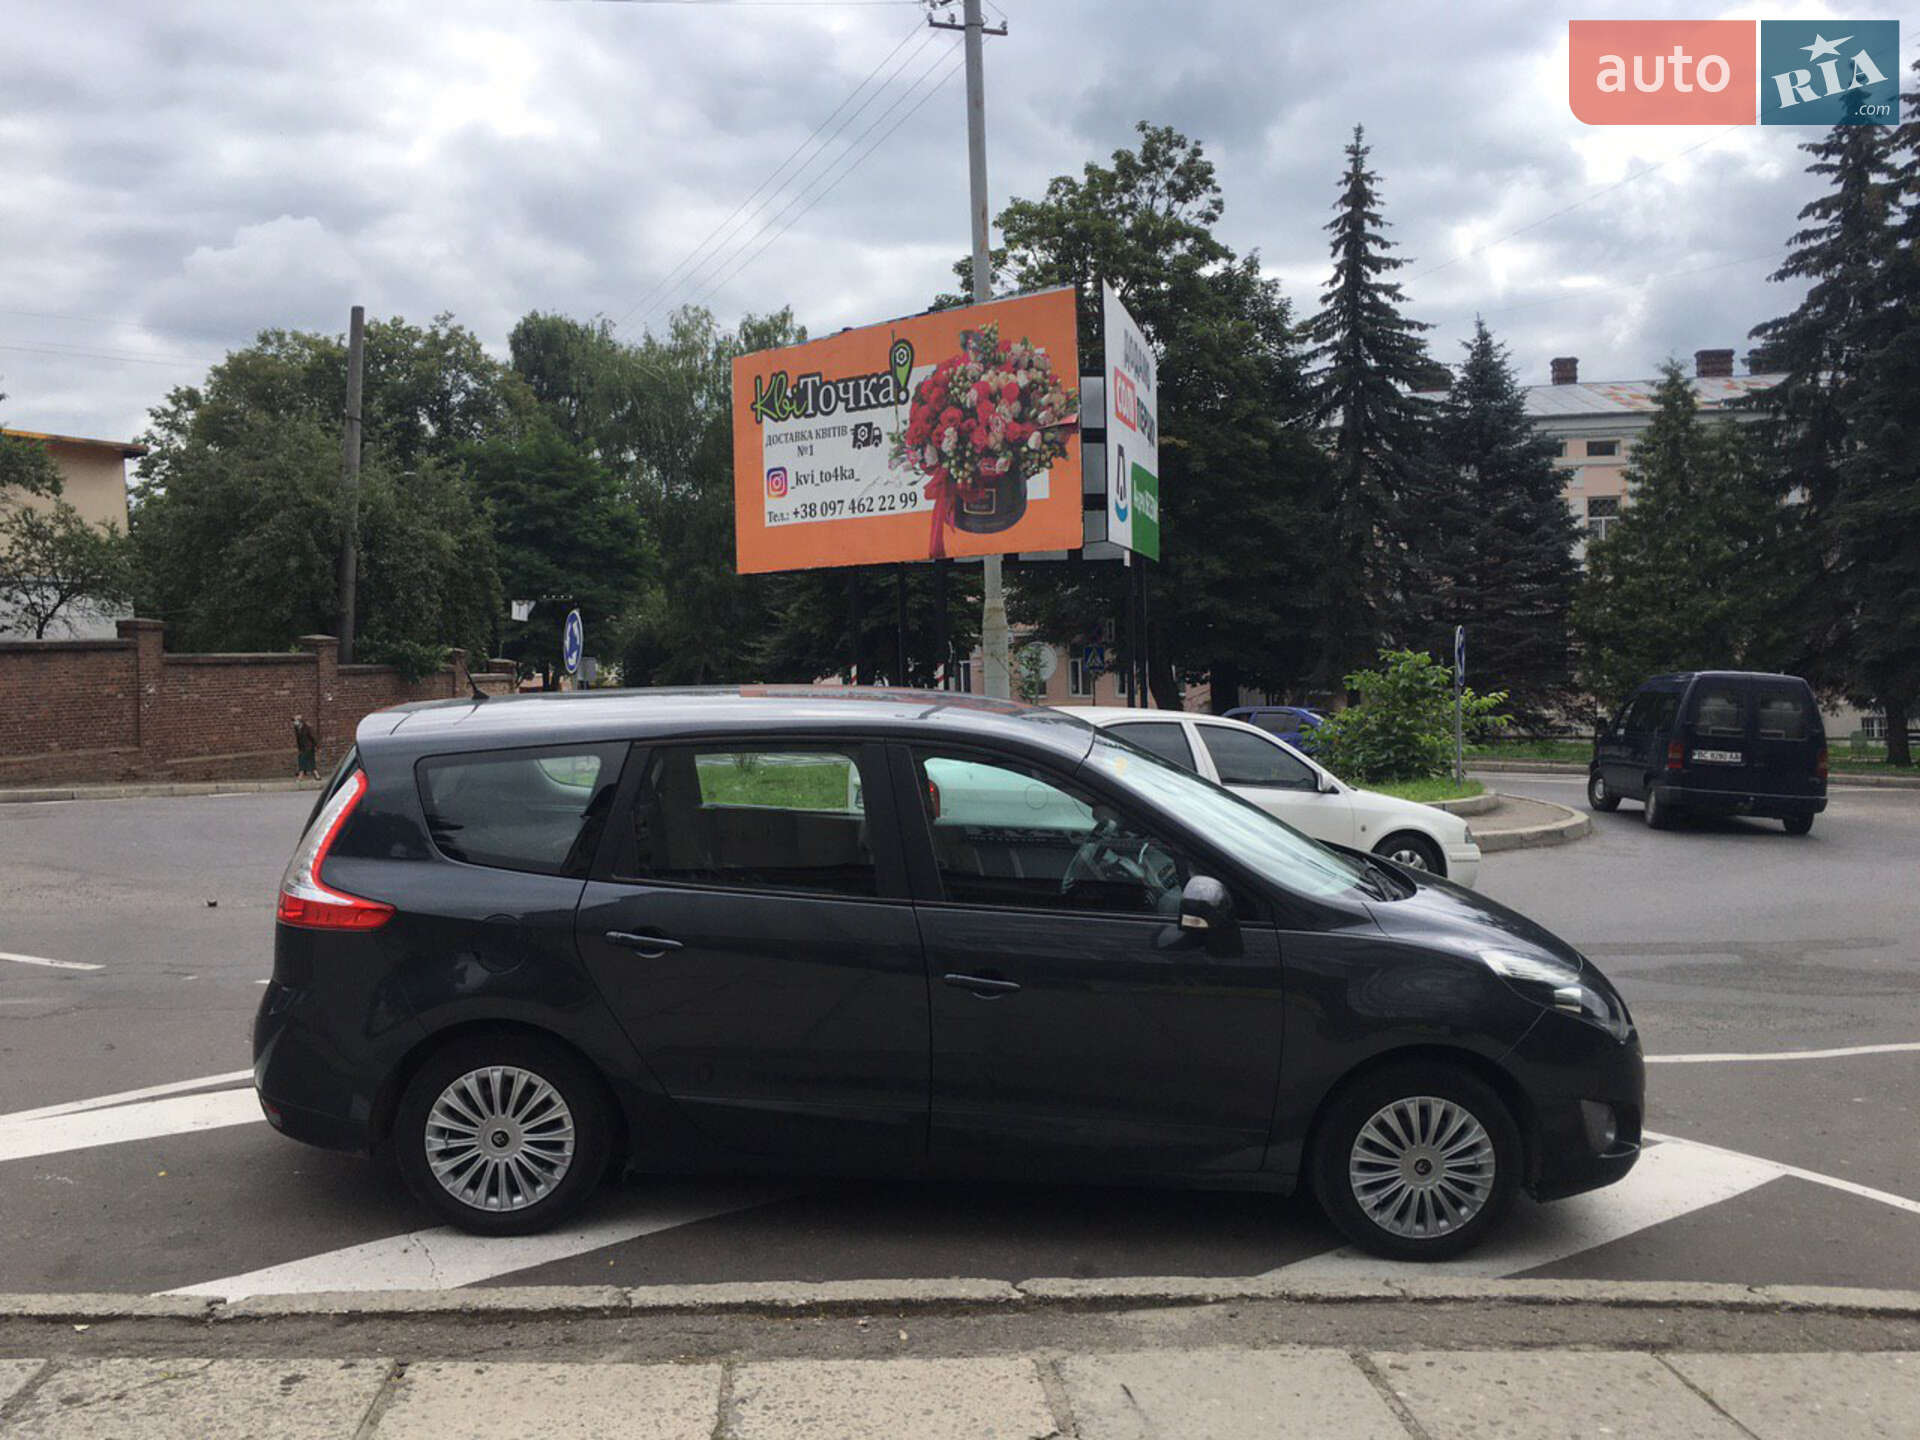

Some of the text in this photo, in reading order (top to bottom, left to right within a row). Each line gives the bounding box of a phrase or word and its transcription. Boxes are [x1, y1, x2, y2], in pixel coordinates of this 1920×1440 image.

[765, 425, 849, 447] ДОСТАВКА КВІТІВ
[793, 502, 818, 520] +38
[820, 499, 845, 517] 097
[848, 496, 874, 514] 462
[878, 494, 896, 512] 22
[899, 491, 918, 510] 99
